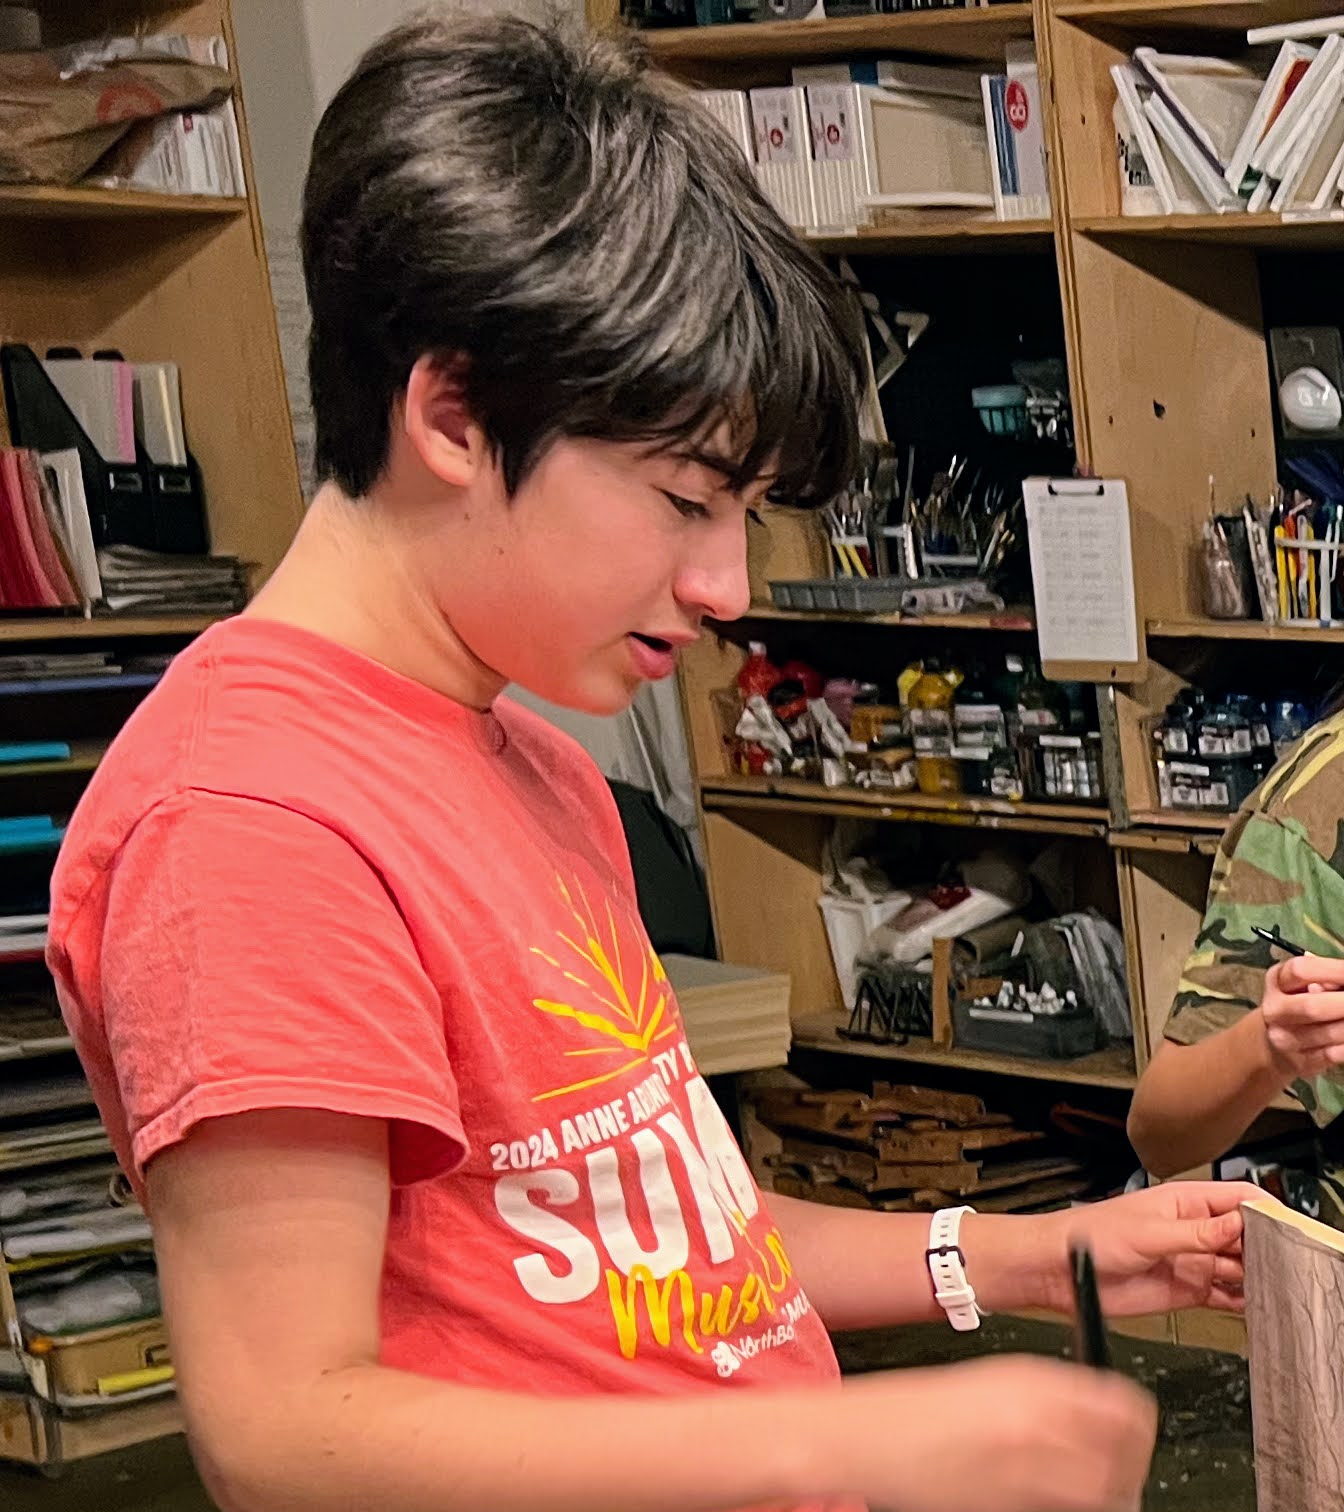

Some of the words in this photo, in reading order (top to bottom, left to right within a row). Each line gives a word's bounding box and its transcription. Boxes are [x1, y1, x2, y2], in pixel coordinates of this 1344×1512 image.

[490, 1127, 558, 1172] 2024
[561, 1098, 631, 1151] ANNE
[494, 1076, 759, 1304] SUM
